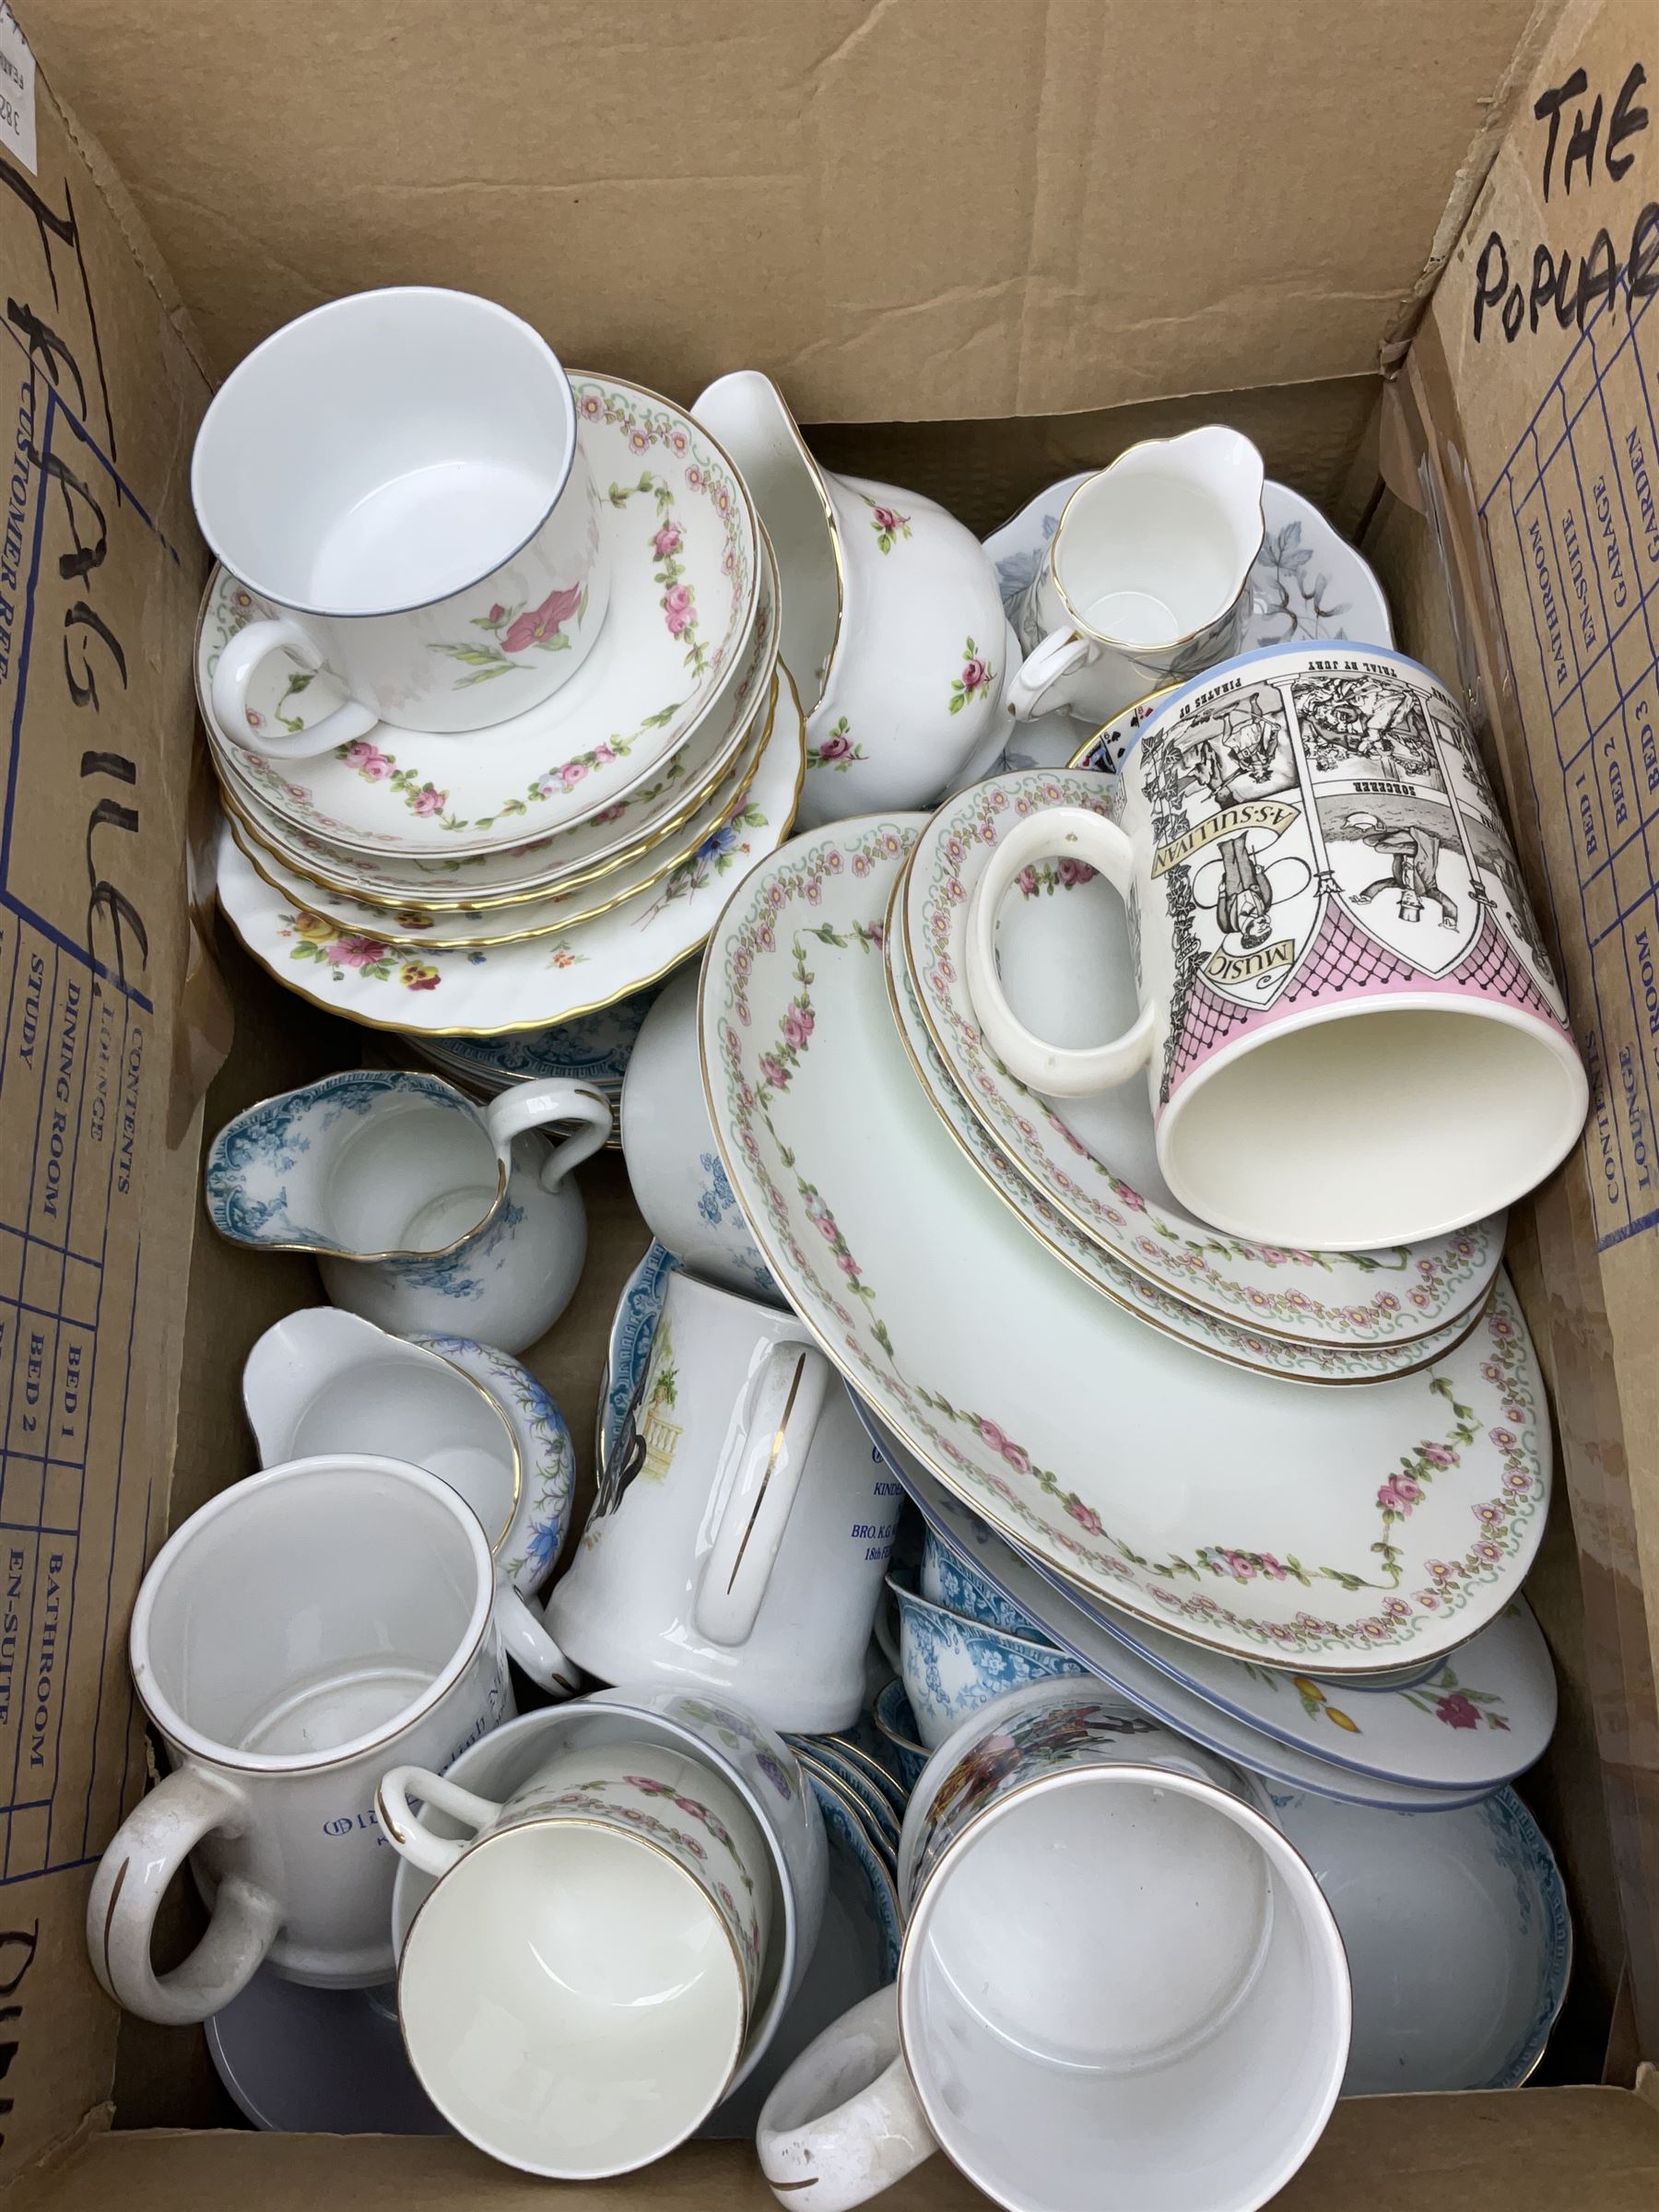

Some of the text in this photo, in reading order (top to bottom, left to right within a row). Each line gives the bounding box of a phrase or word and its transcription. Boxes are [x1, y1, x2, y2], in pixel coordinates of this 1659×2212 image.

[1534, 62, 1649, 204] THE
[2, 381, 33, 590] CUSTOMER
[1593, 475, 1628, 608] GARAGE
[1626, 425, 1659, 563] GARDEN
[1528, 516, 1567, 688] BATHROOM
[1562, 509, 1596, 652] EN-SUITE
[1179, 678, 1242, 719] PIRATES OF
[1308, 661, 1397, 677] TRIAL BY JURY
[1352, 782, 1417, 796] SORCERER
[1604, 736, 1629, 830] BED 2
[1635, 700, 1659, 795] BED 3
[1575, 773, 1599, 858] BED 1
[18, 952, 45, 1070] STUDY
[1207, 943, 1288, 980] MUSIC
[1635, 926, 1659, 1039] ROOM
[42, 979, 81, 1219] DINING ROOM
[90, 1003, 116, 1143] LOUNGE
[117, 1027, 144, 1195] CONTENTS
[1585, 1030, 1620, 1205] CONTENTS
[1618, 1045, 1652, 1192] LOUNGE
[22, 1332, 44, 1431] BED 2
[61, 1343, 83, 1438] BED 1
[0, 1548, 24, 1725] EN-SUITE
[30, 1553, 65, 1769] BATHROOM
